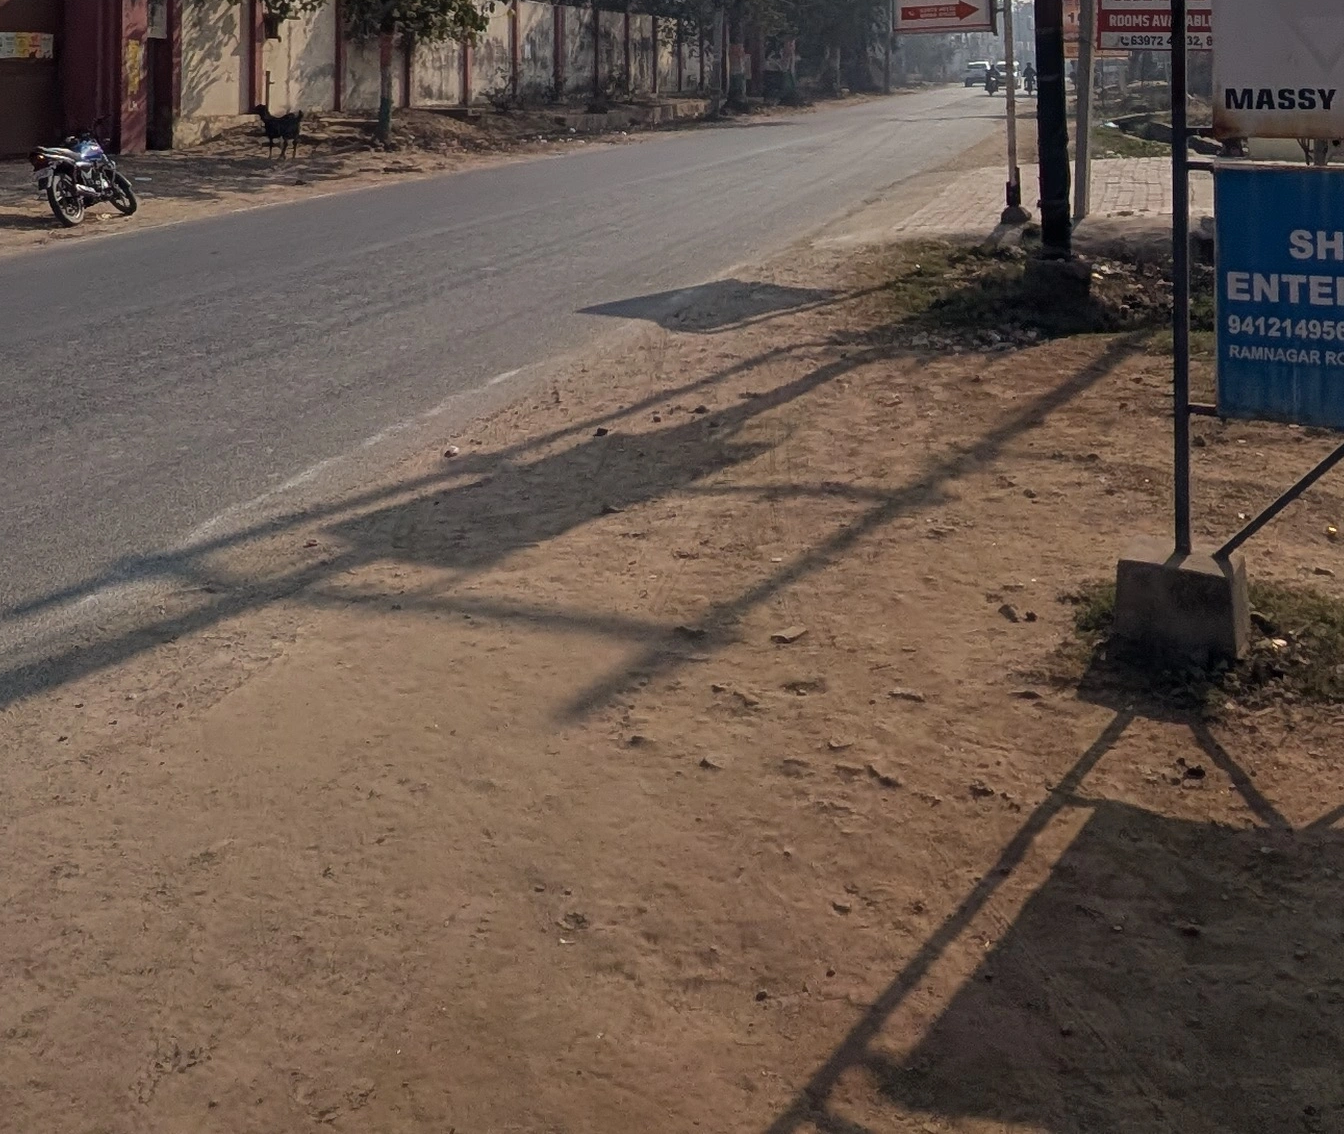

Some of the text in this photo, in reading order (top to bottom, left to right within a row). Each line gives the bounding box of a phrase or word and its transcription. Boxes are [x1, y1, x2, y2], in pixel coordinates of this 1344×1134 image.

[1109, 14, 1150, 27] ROOMS
[1225, 87, 1337, 111] MASSY
[1229, 344, 1321, 365] RAMNAGAR
